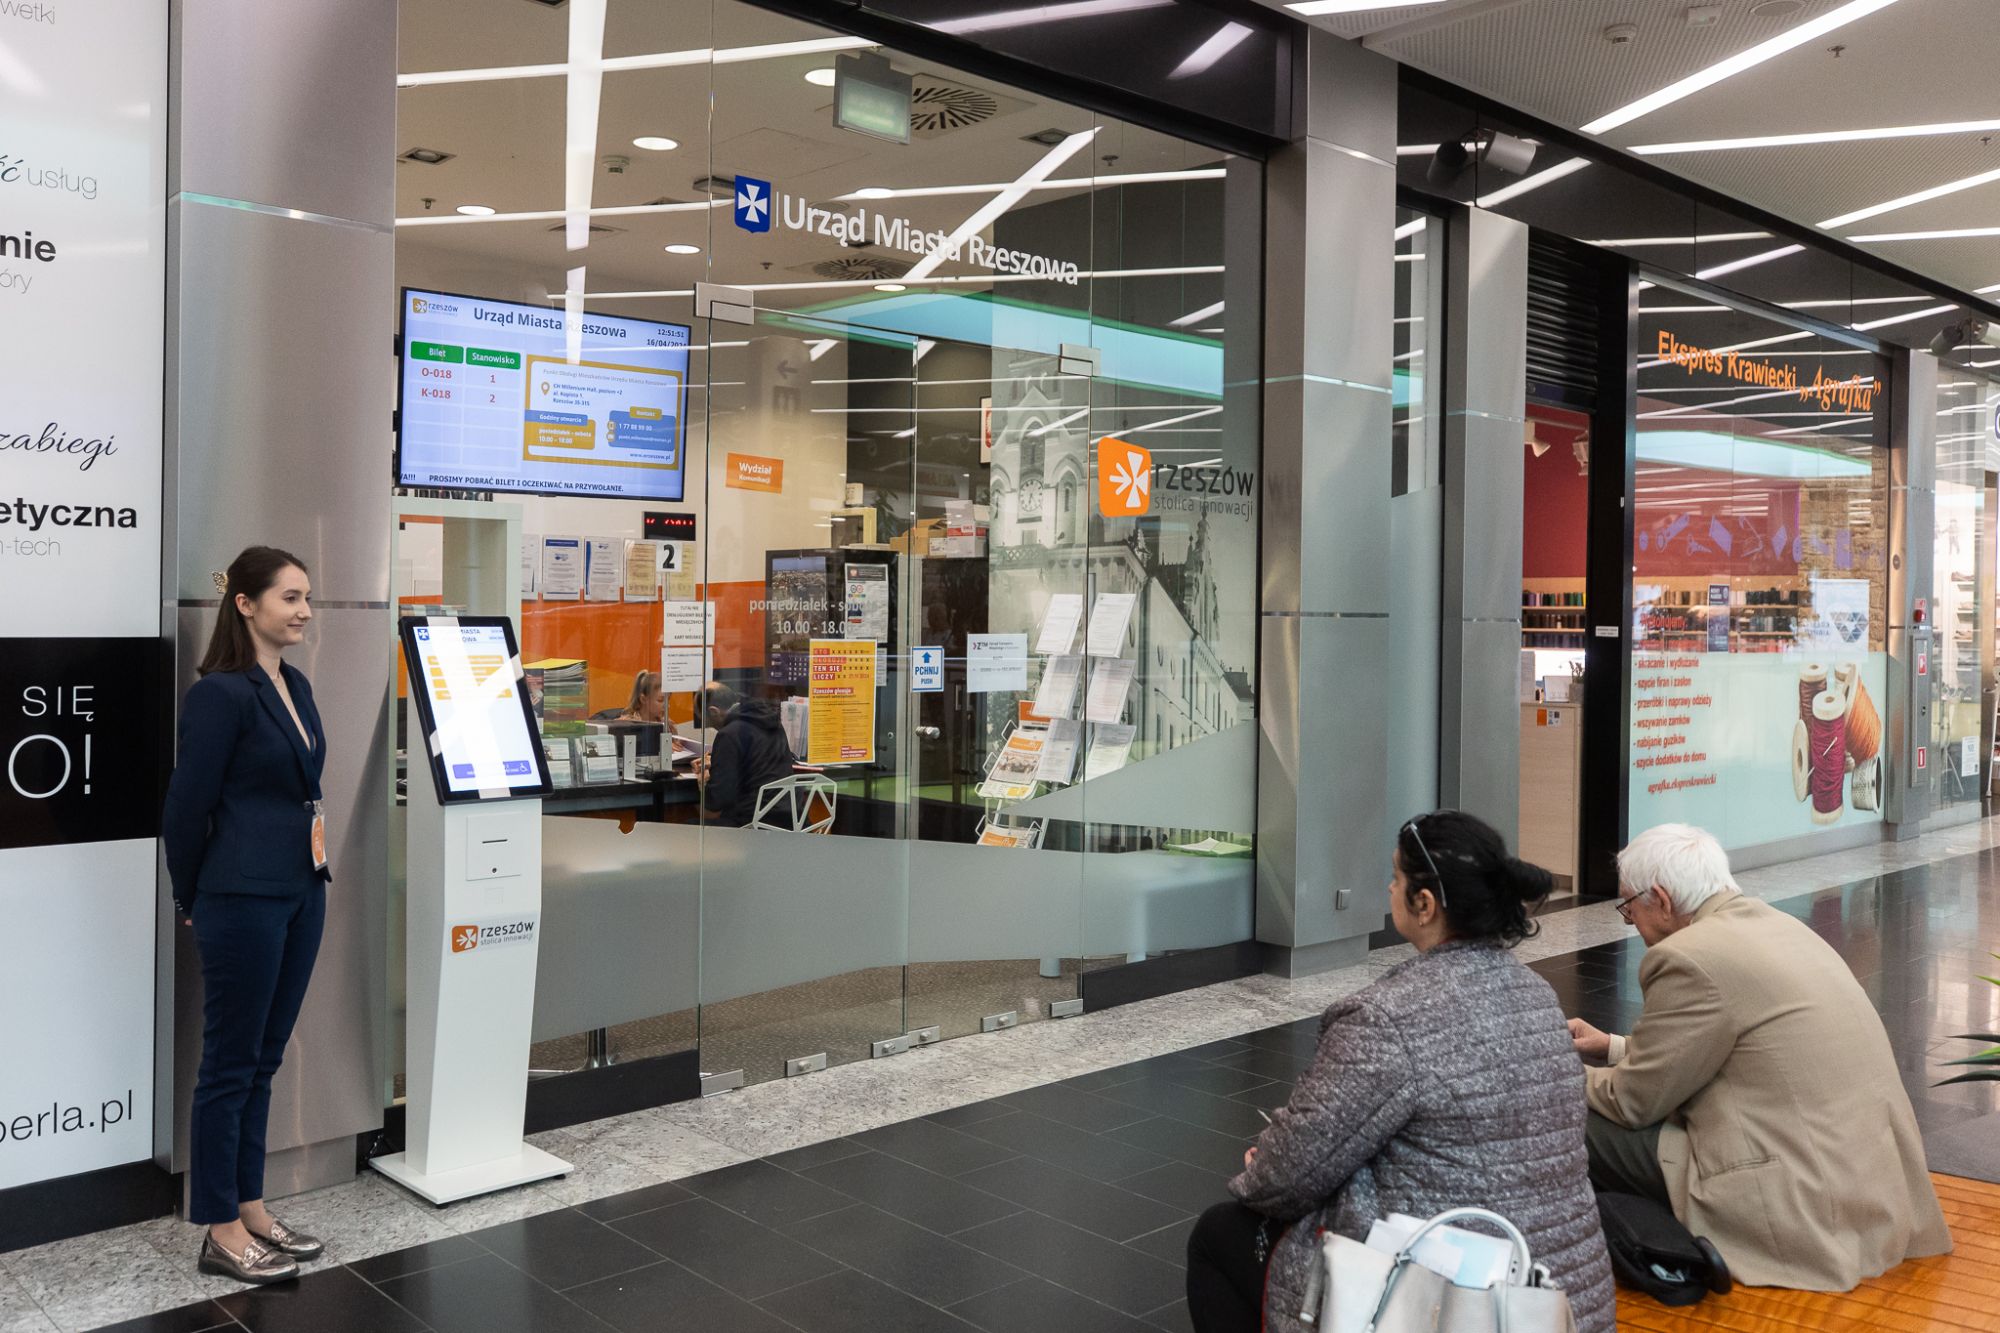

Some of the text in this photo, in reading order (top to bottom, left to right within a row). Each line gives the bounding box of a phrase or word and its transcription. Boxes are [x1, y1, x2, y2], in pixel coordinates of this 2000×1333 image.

[28, 167, 97, 200] usług
[0, 231, 56, 262] nie
[784, 194, 1079, 286] Urząd Miasta Rzeszowa
[474, 307, 514, 327] Urząd
[518, 313, 563, 331] Miasta
[658, 329, 685, 338] 12:51:51
[429, 347, 515, 365] Bilet Stanowisko
[1658, 330, 1723, 375] Ekspres
[1727, 351, 1797, 391] Krawiecki
[490, 374, 496, 384] 1
[421, 388, 496, 403] K-018 2
[739, 462, 772, 474] Wydział
[429, 474, 462, 484] PROSIMY
[464, 477, 494, 486] POBRAĆ
[495, 479, 515, 487] BILET
[521, 480, 563, 489] OCZEKIWAĆ
[575, 483, 624, 492] PRZYWOŁANIE.
[1155, 463, 1254, 497] rzeszów
[1154, 494, 1254, 522] stolica innowacji
[0, 536, 61, 556] -tech
[662, 544, 675, 569] 2
[749, 597, 828, 614] poniedziałek
[776, 620, 810, 634] 10.00
[821, 620, 852, 634] 18.0
[915, 666, 939, 676] PCHNIJ
[22, 686, 95, 722] SIĘ
[480, 921, 534, 938] rzeszów
[480, 936, 502, 946] stolica
